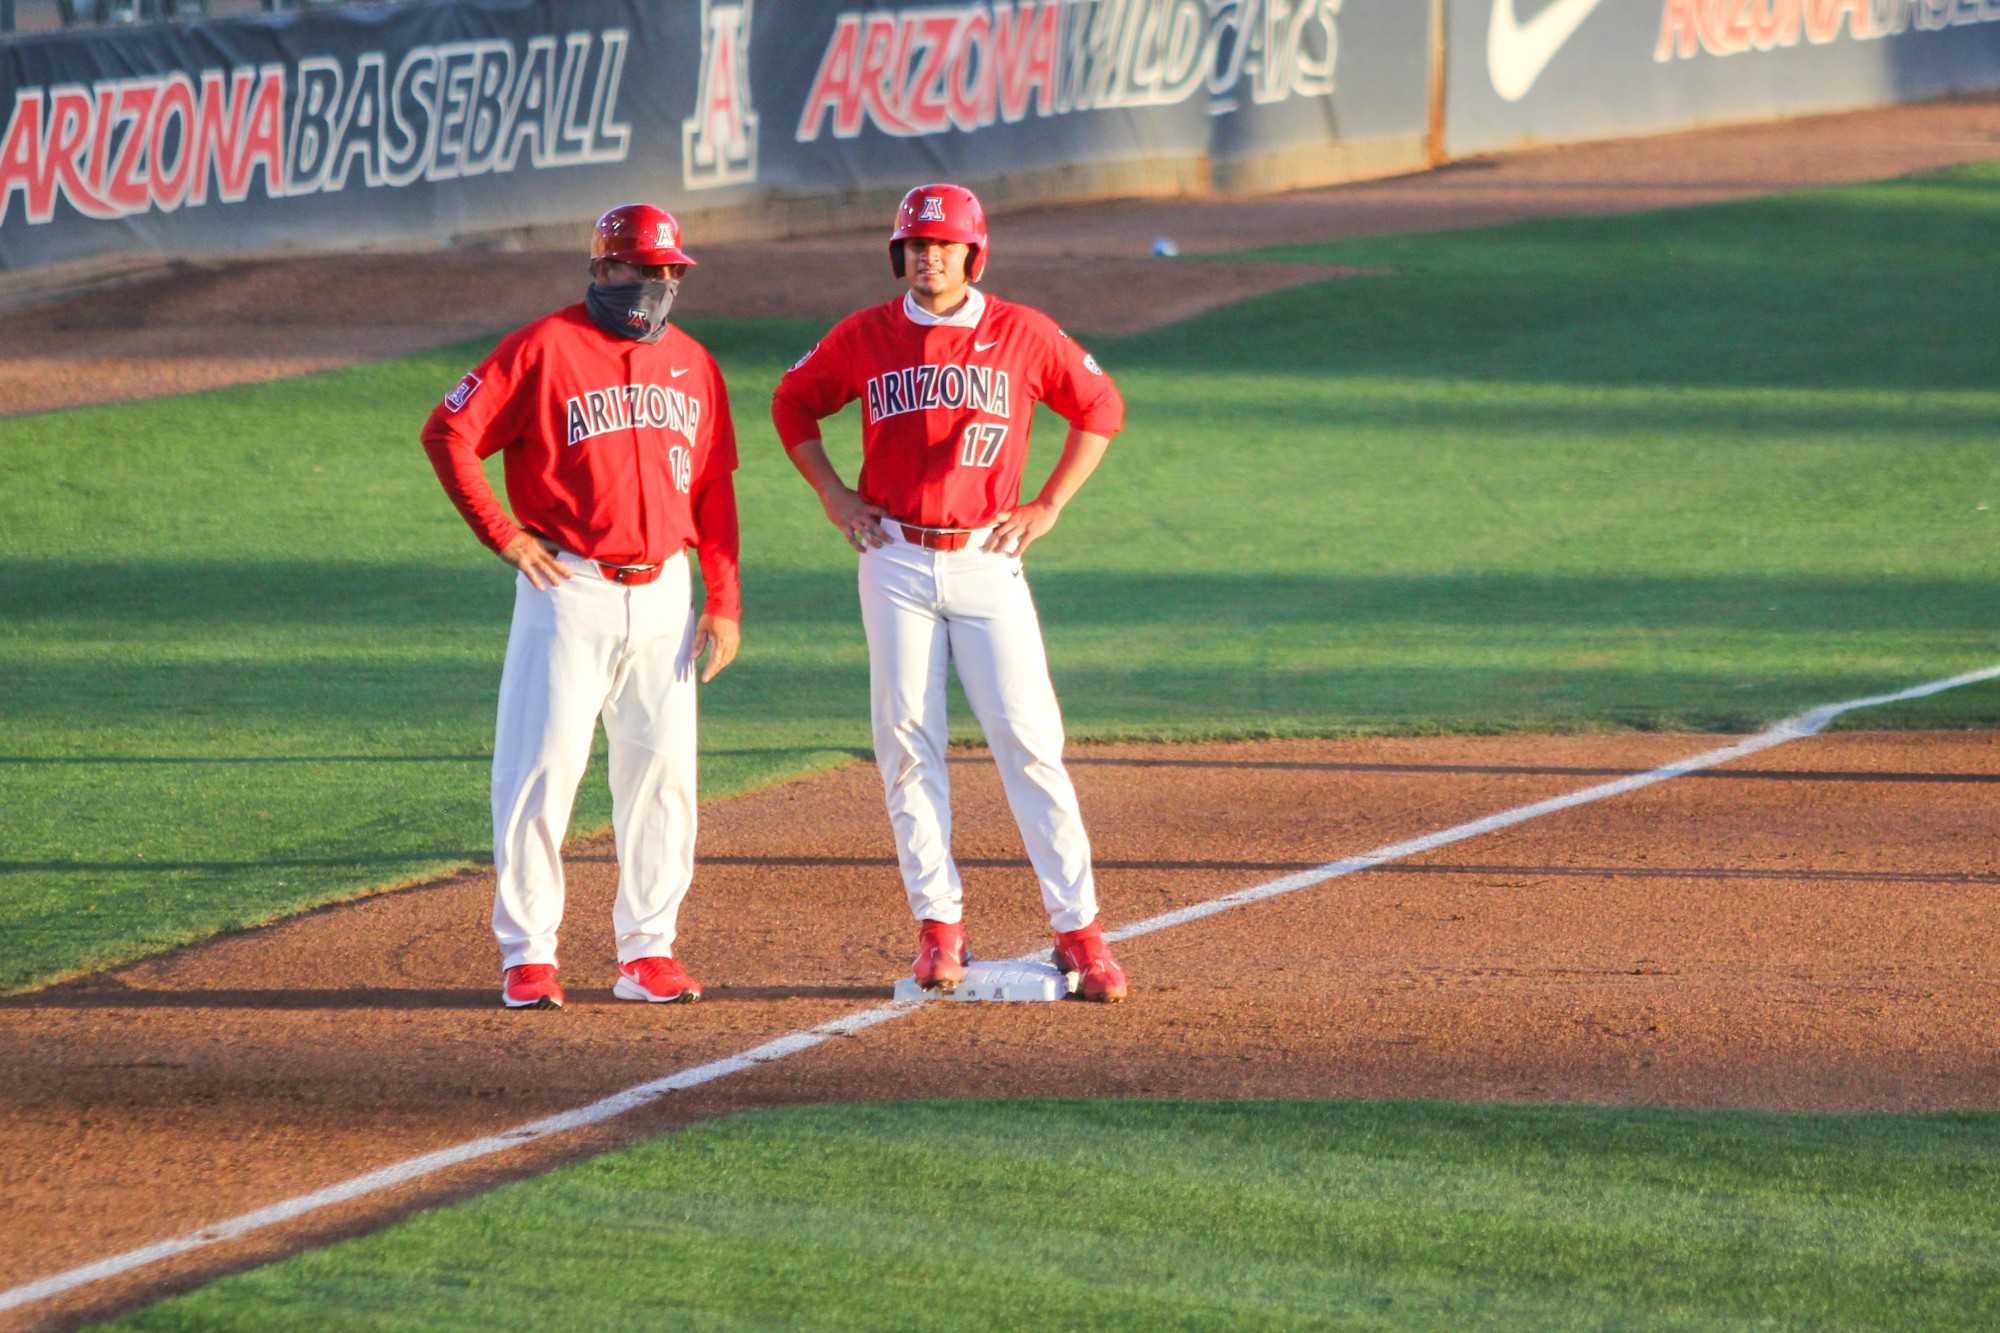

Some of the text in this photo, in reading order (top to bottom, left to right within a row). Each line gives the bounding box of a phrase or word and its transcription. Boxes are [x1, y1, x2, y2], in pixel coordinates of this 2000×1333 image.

[682, 0, 760, 190] A
[795, 0, 1056, 142] ARIZONA
[0, 29, 632, 227] ARIZONA BASEBALL
[654, 223, 676, 249] A
[919, 196, 945, 222] A
[566, 384, 700, 447] ARIZONA
[867, 364, 1010, 424] ARIZONA
[961, 423, 1009, 468] 17
